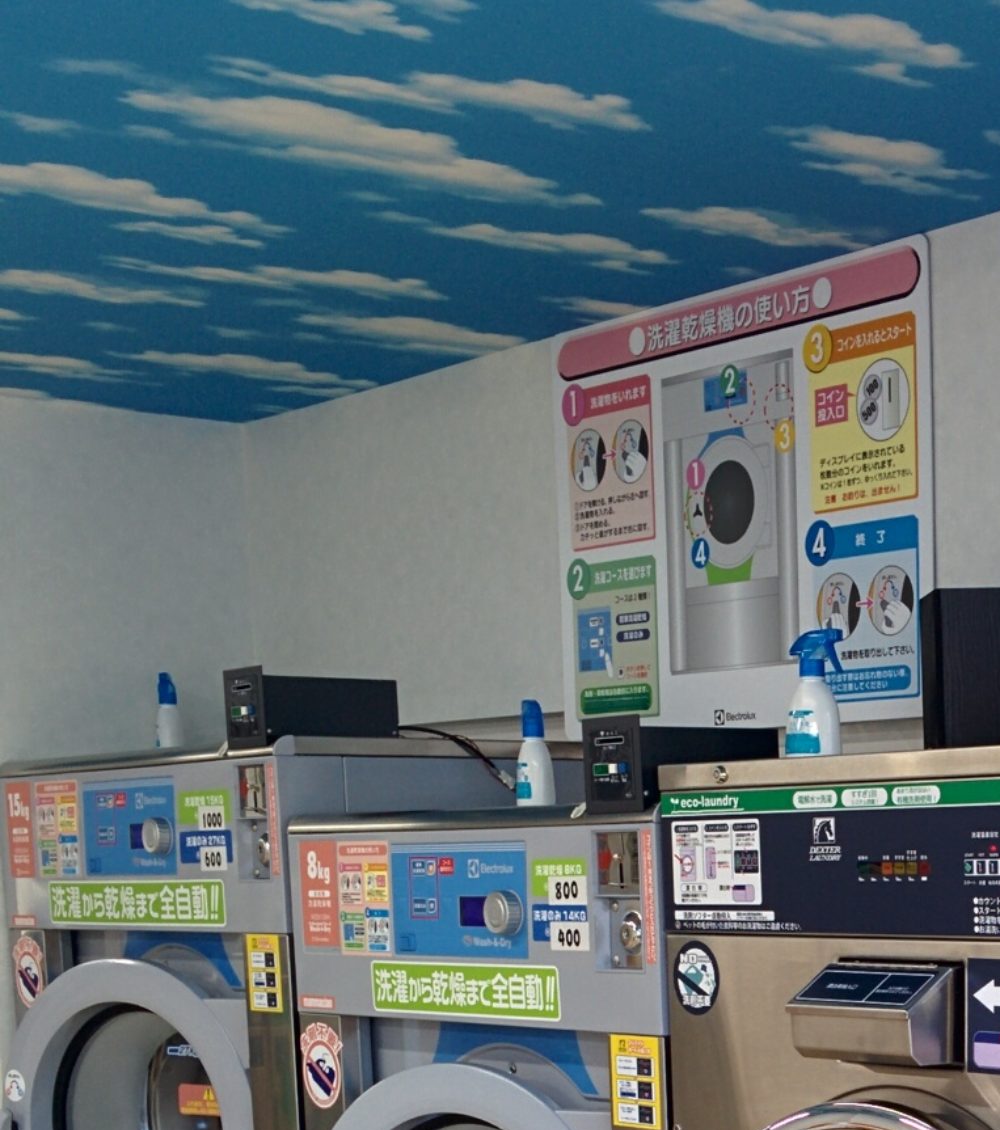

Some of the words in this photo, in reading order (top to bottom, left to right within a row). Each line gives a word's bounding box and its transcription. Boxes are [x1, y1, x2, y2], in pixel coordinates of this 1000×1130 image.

[647, 286, 811, 351] 洗濯乾燥機の使い方
[810, 332, 824, 364] 3
[724, 367, 736, 394] 2
[570, 390, 577, 417] 1
[817, 389, 845, 406] コイン
[779, 423, 790, 449] 3
[812, 527, 826, 558] 4
[695, 541, 706, 564] 4
[573, 565, 584, 592] 2
[680, 795, 739, 809] eco-laundry
[202, 813, 222, 828] 1000
[205, 852, 221, 867] 600
[809, 846, 841, 854] DEXTER
[307, 851, 331, 884] 8kg
[480, 862, 514, 875] Electrolux
[564, 863, 582, 875] 8KG
[555, 881, 578, 900] 800
[563, 910, 586, 922] 14KG
[558, 929, 581, 947] 400
[680, 954, 698, 964] NO
[375, 968, 555, 1010] 洗濯から乾燥まで全自動!!
